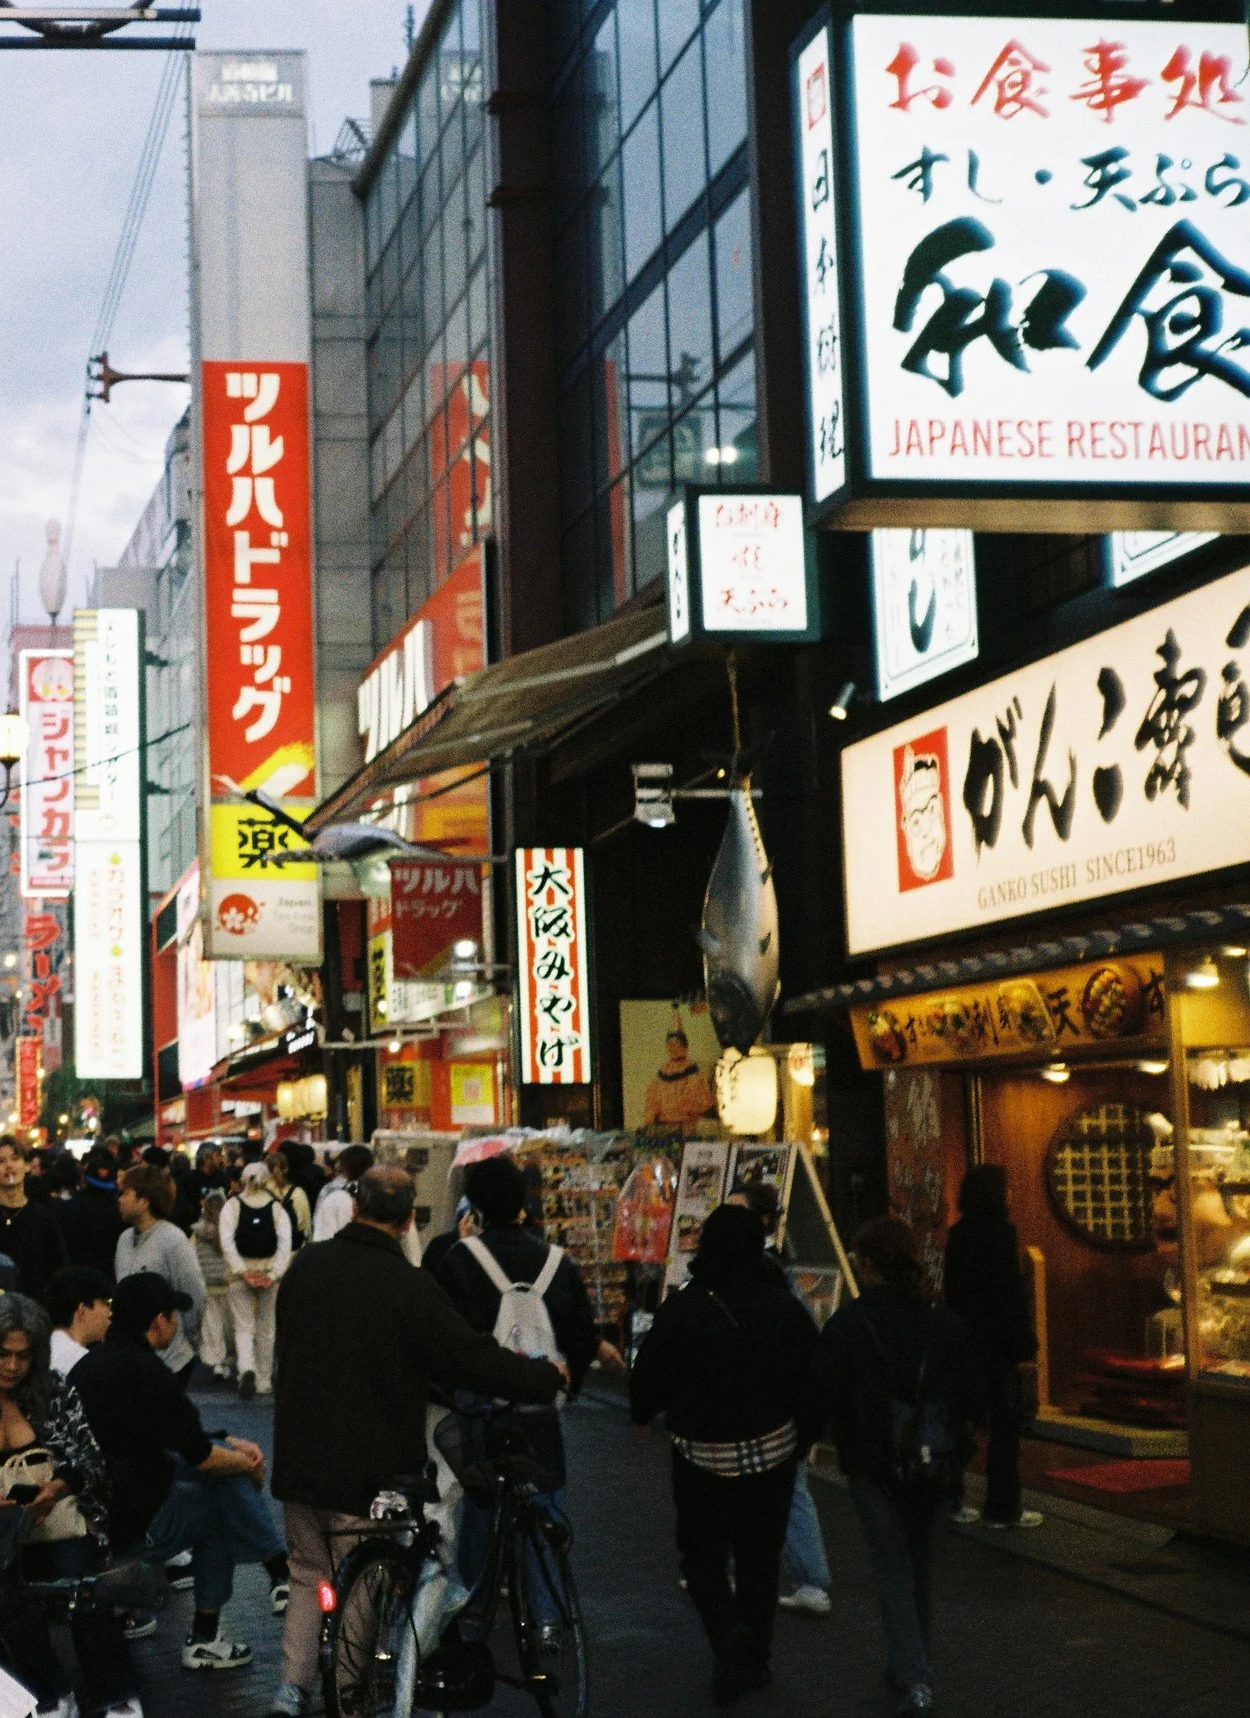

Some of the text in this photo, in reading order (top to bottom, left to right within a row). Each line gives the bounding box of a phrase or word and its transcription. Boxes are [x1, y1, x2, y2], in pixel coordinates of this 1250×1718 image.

[884, 37, 1248, 126] お食事処
[892, 215, 1250, 402] 和食
[889, 418, 1250, 462] JAPANESE RESTAURAN
[225, 372, 291, 742] ツルハドラッグ
[237, 817, 289, 870] 薬
[394, 867, 480, 895] ツルハ
[978, 875, 1028, 910] GANKO
[1031, 863, 1077, 899] SUSHI
[395, 899, 464, 919] ドラッグ
[532, 865, 579, 1068] 大阪みやげ
